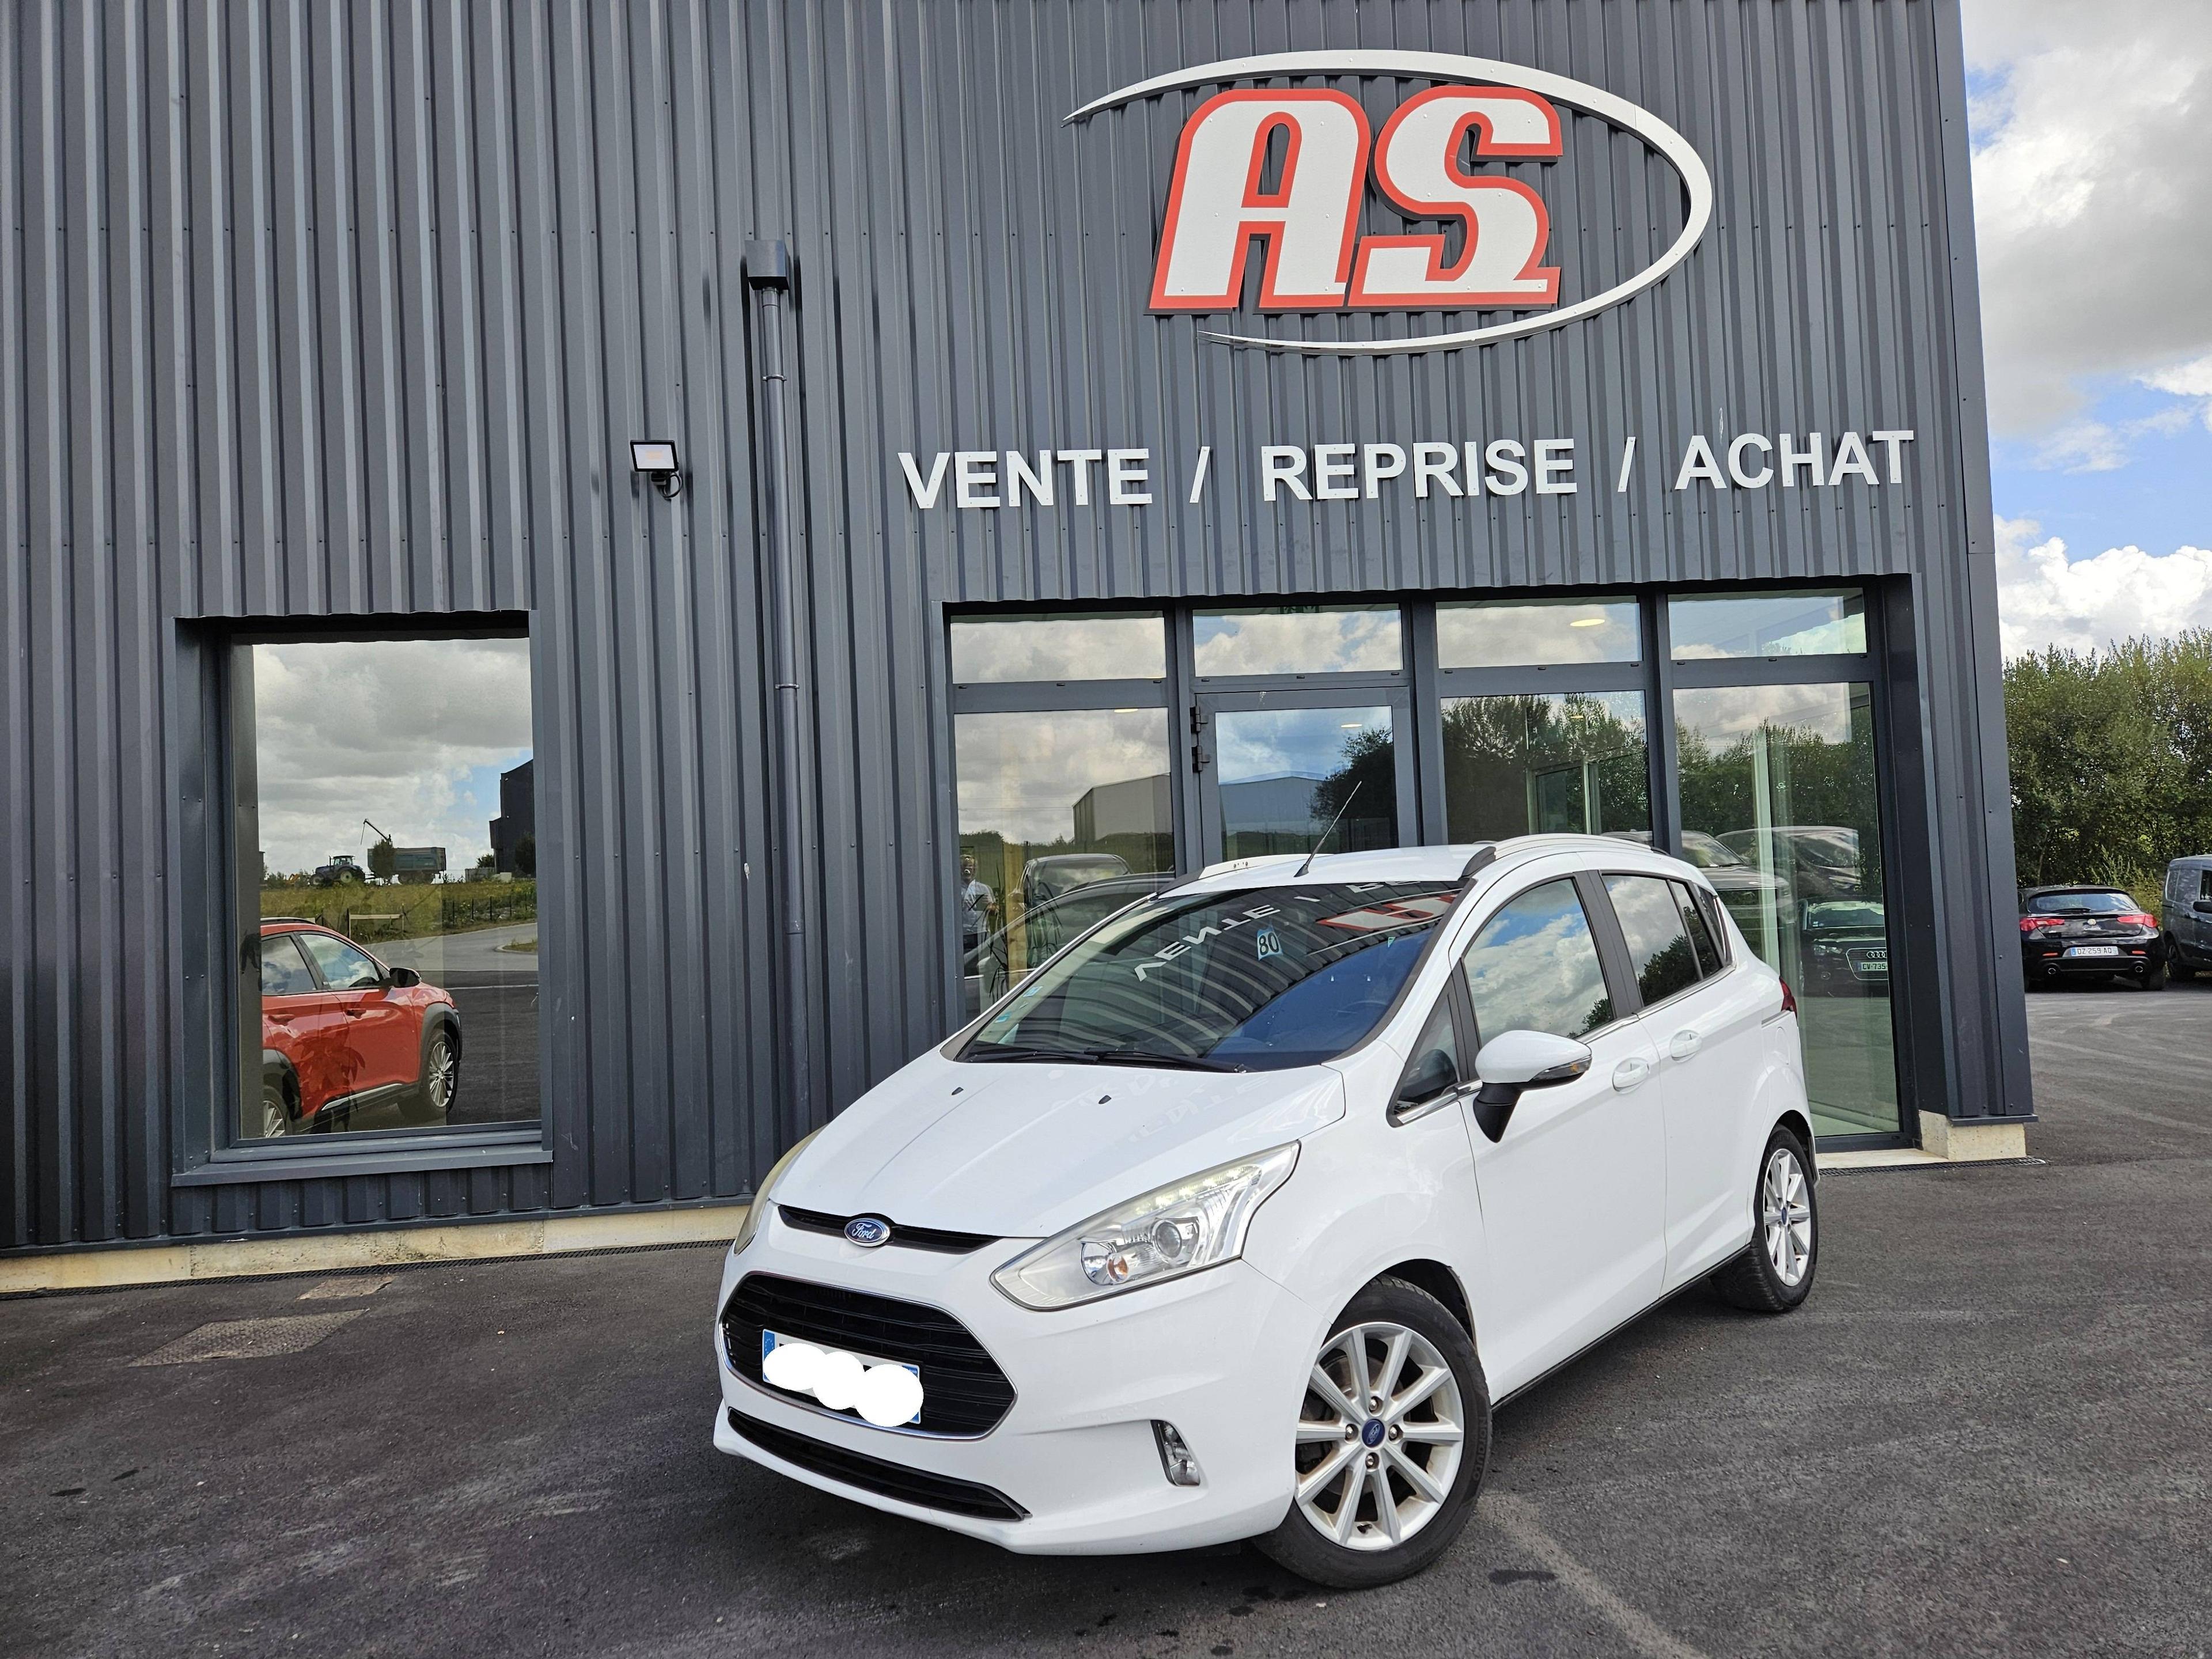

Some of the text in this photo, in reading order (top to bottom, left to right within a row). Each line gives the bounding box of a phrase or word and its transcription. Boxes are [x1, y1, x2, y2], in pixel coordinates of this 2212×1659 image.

[1149, 85, 1563, 309] AS
[897, 430, 1915, 509] VENTE / REPRISE / ACHAT
[1258, 931, 1279, 956] 80
[851, 1222, 877, 1239] Ford
